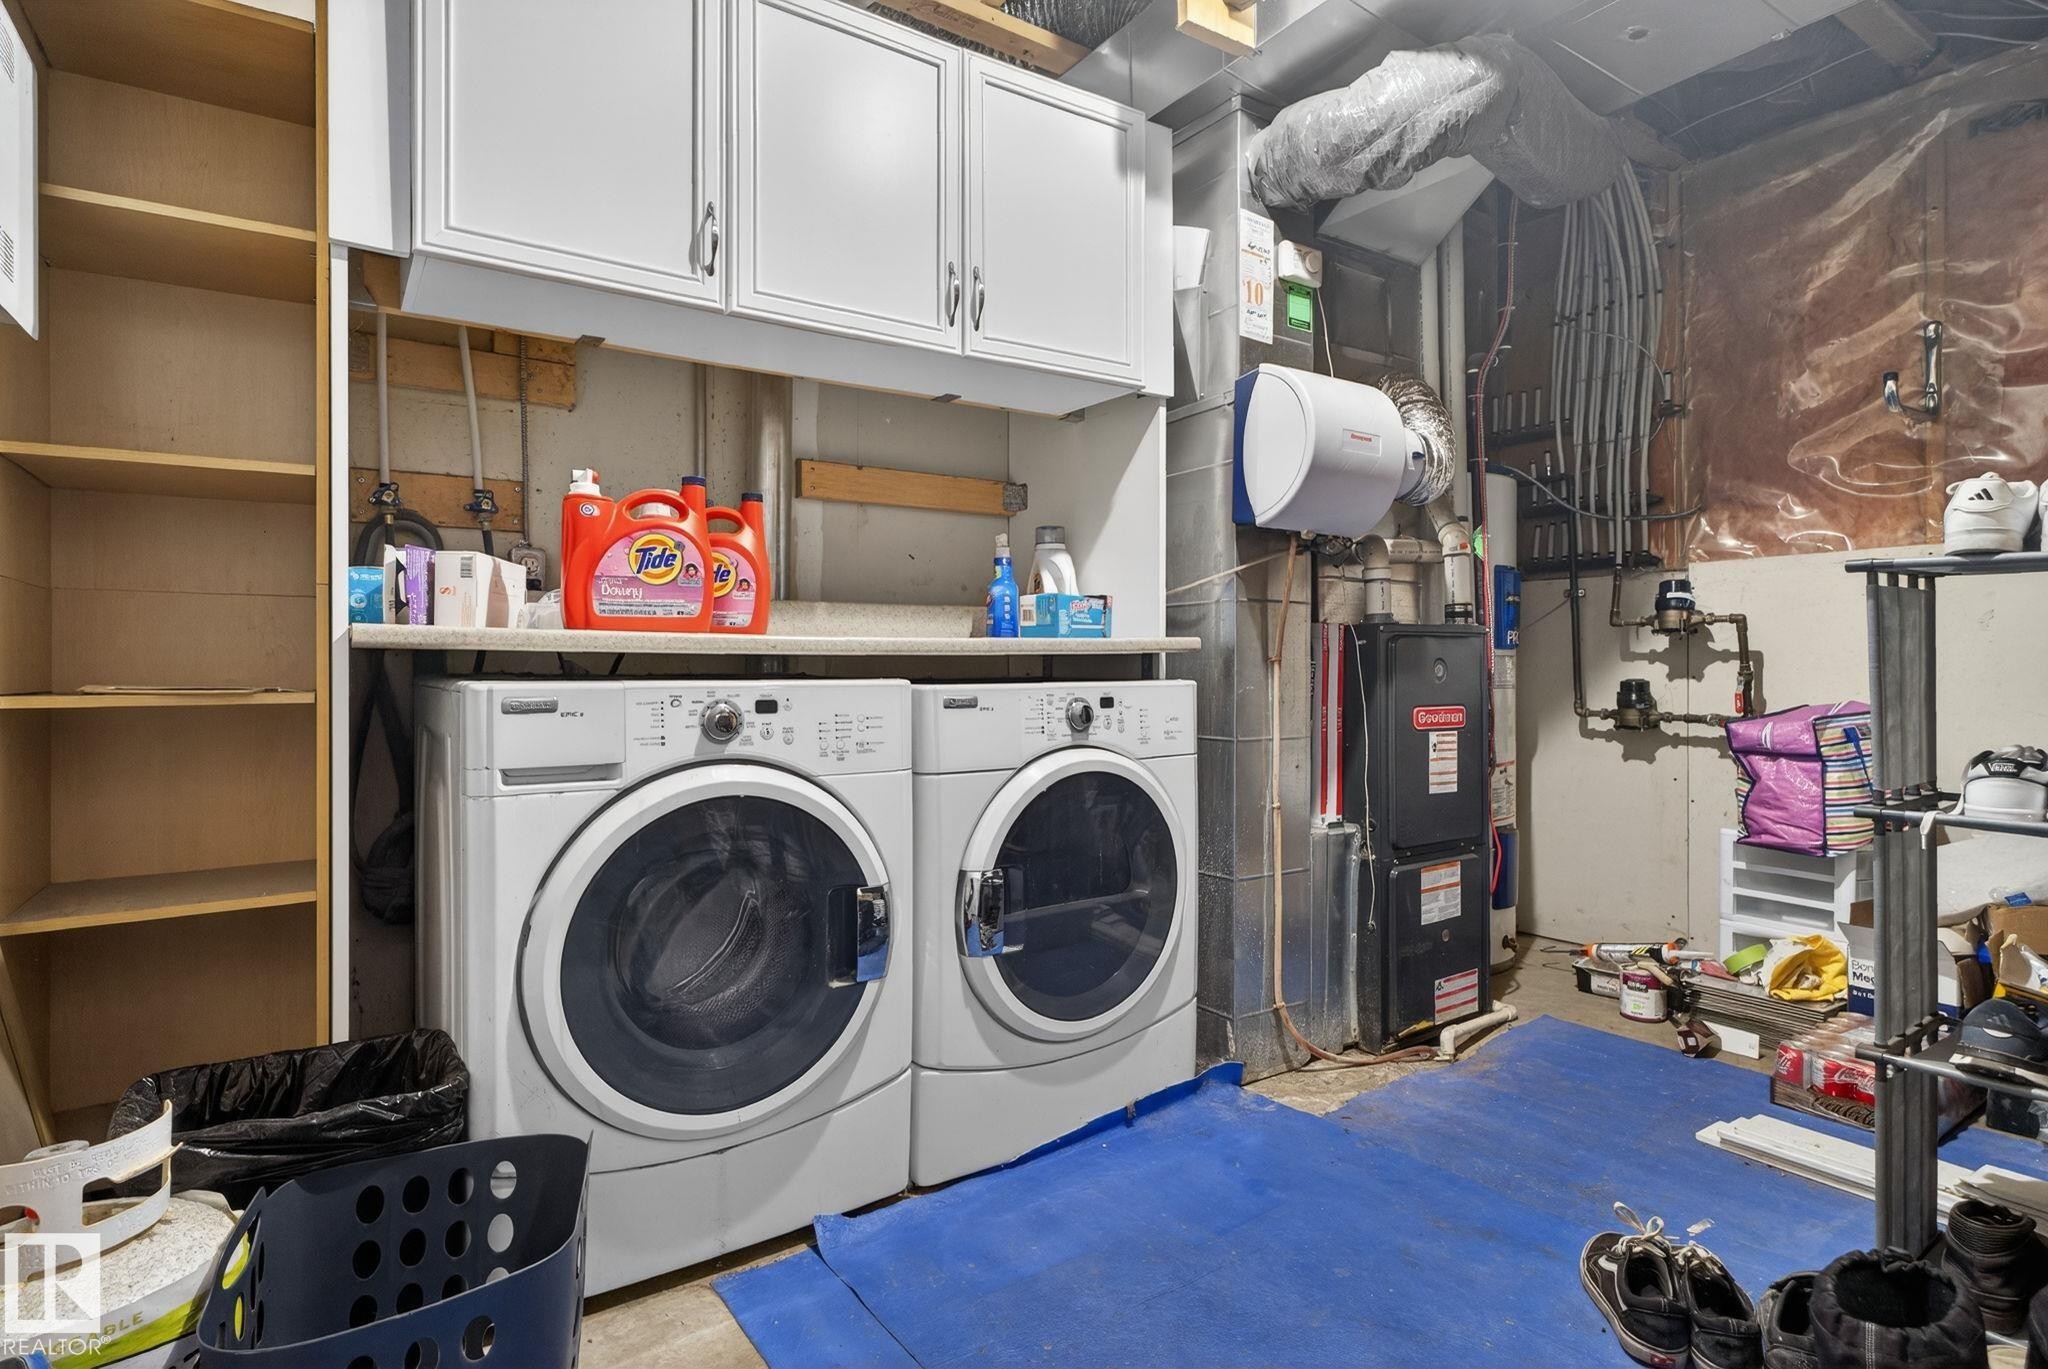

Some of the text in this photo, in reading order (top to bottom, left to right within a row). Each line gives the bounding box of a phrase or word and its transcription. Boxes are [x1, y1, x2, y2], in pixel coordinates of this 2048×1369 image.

[635, 546, 678, 575] Tide
[713, 563, 731, 584] de
[601, 582, 643, 599] Downy
[1418, 710, 1464, 724] Goodman
